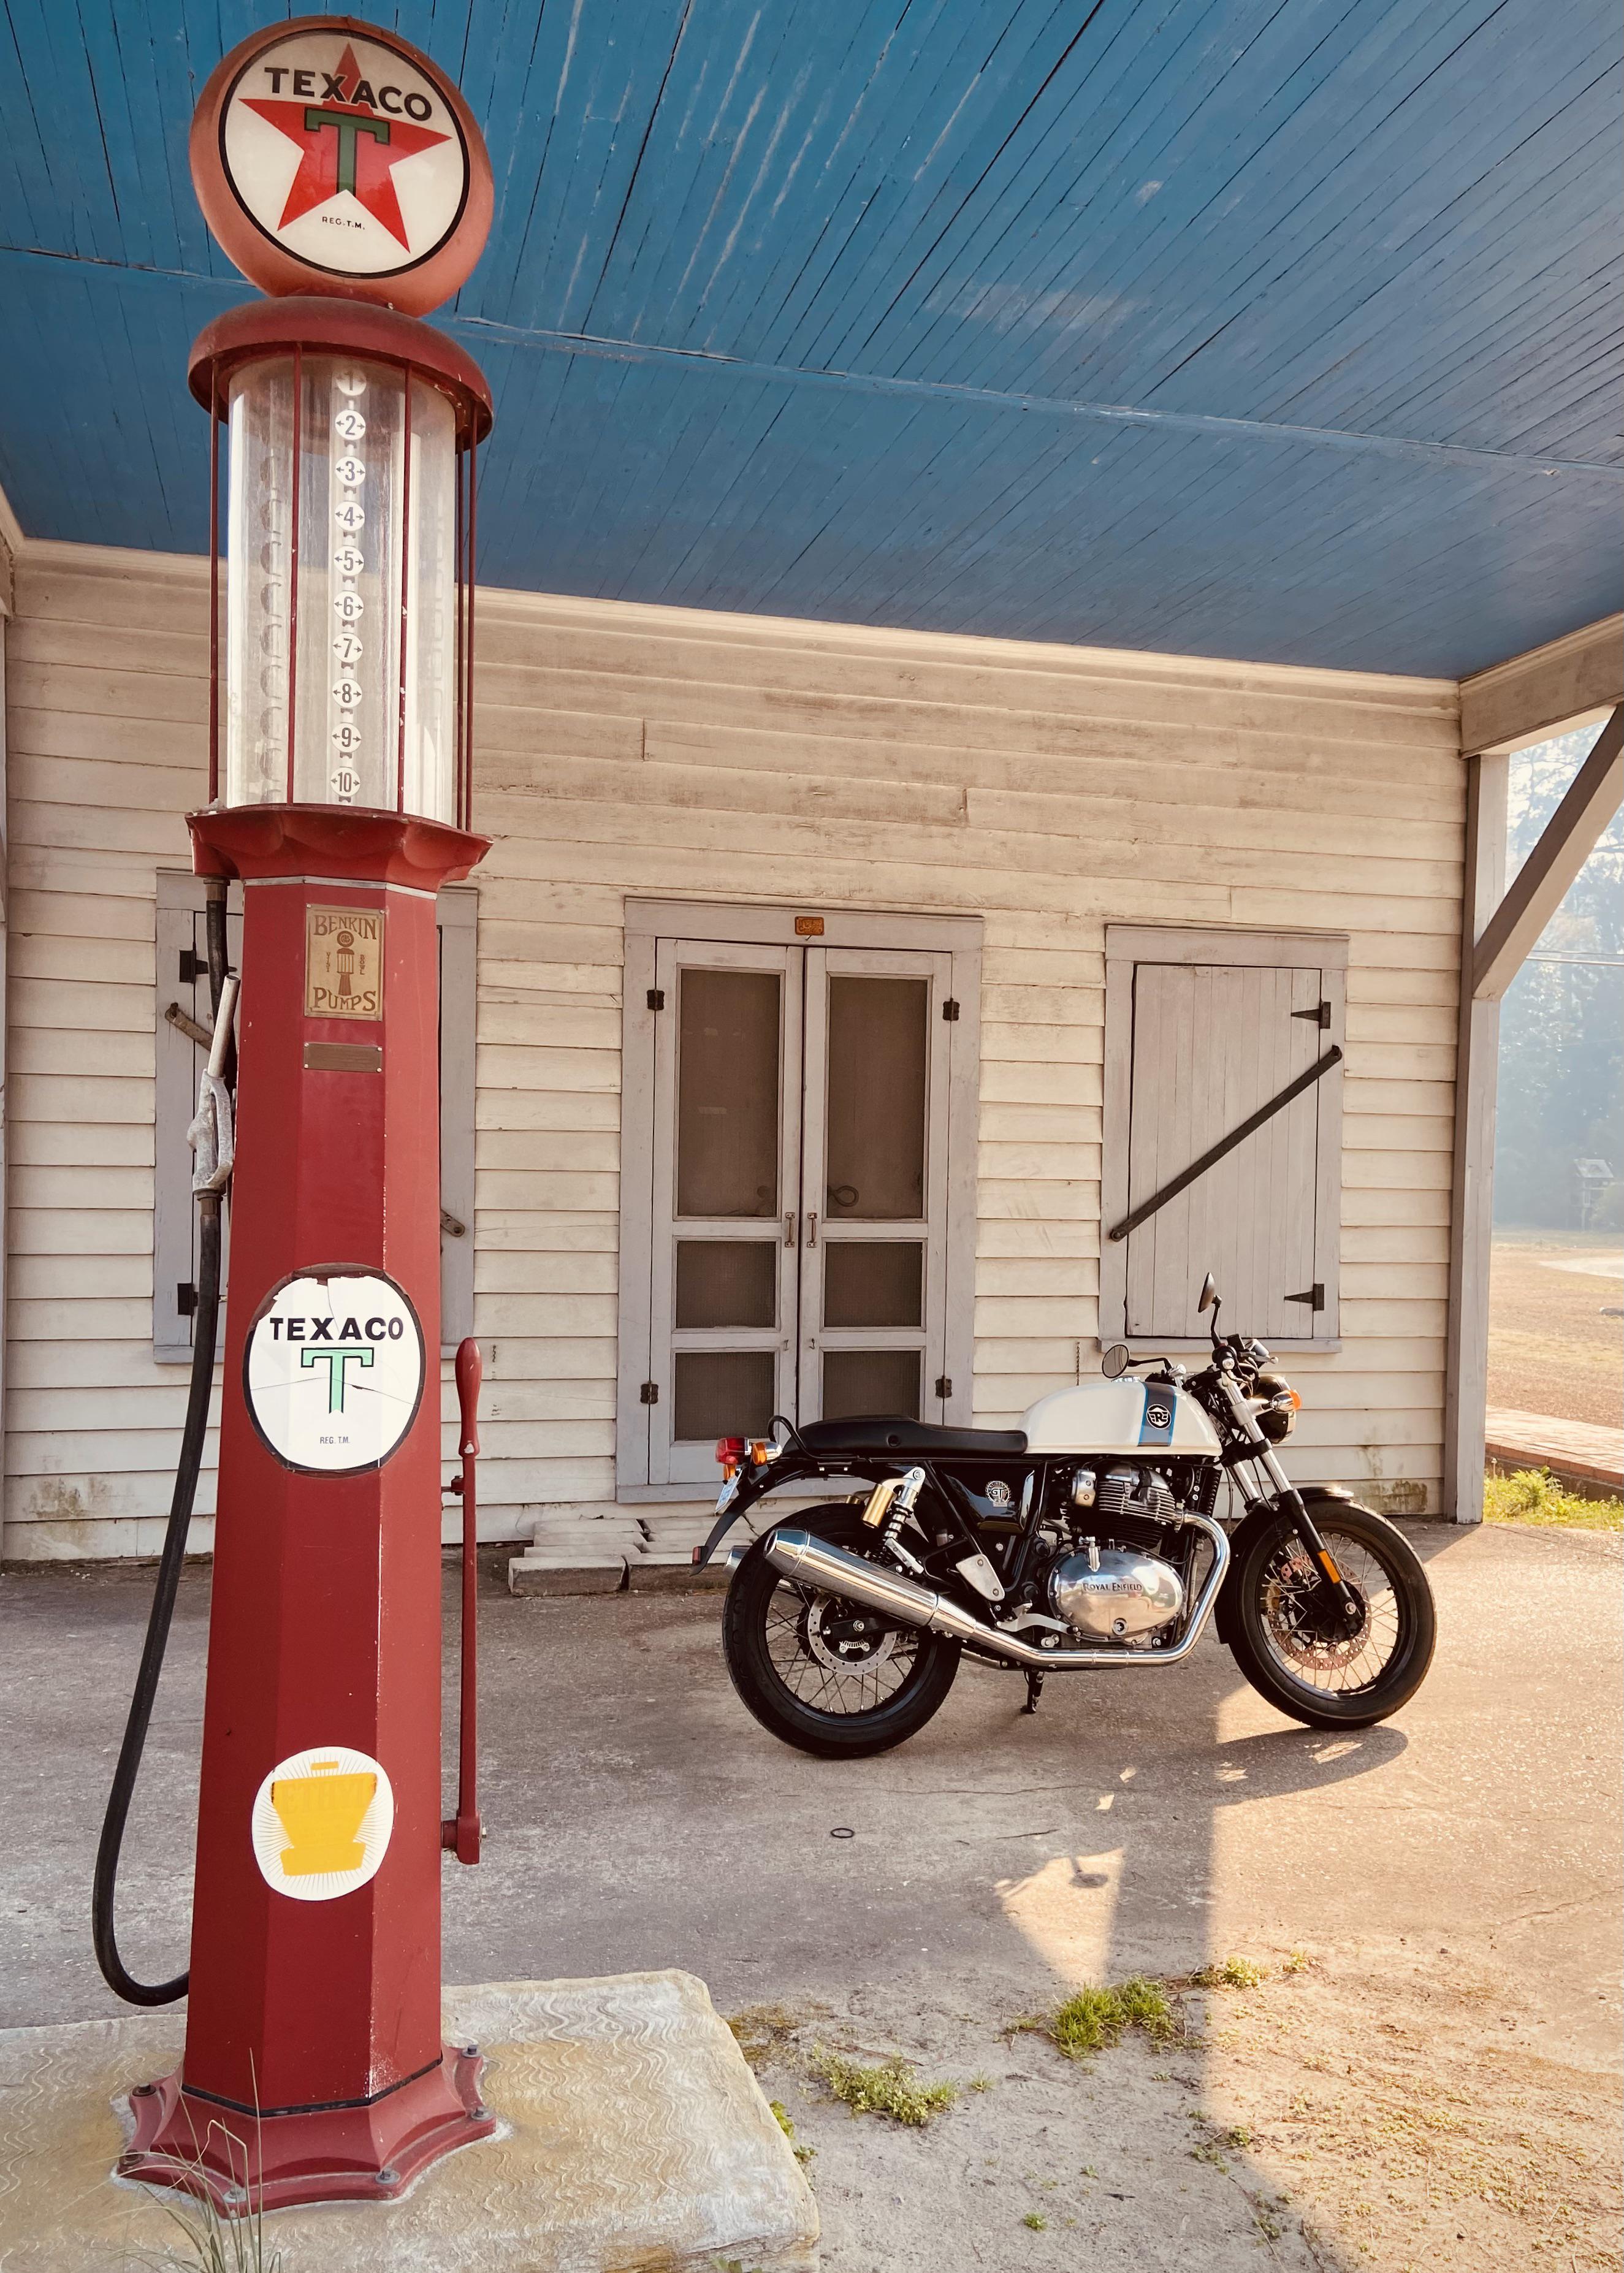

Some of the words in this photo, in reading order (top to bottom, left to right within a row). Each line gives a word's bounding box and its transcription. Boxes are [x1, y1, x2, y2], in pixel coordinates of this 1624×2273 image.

[264, 67, 432, 121] TEXACO
[345, 415, 356, 435] 2
[345, 460, 356, 482] 3
[343, 506, 355, 527] 4
[343, 550, 354, 571] 5
[343, 596, 354, 617] 6
[343, 638, 353, 658] 7
[341, 683, 352, 704] 8
[341, 727, 352, 748] 9
[338, 771, 352, 793] 10
[313, 915, 377, 940] BENKIN
[313, 986, 376, 1011] PUMPS
[270, 1317, 404, 1341] TEXACO
[1083, 1583, 1110, 1592] ROYAL
[1112, 1582, 1142, 1592] ENFIELD
